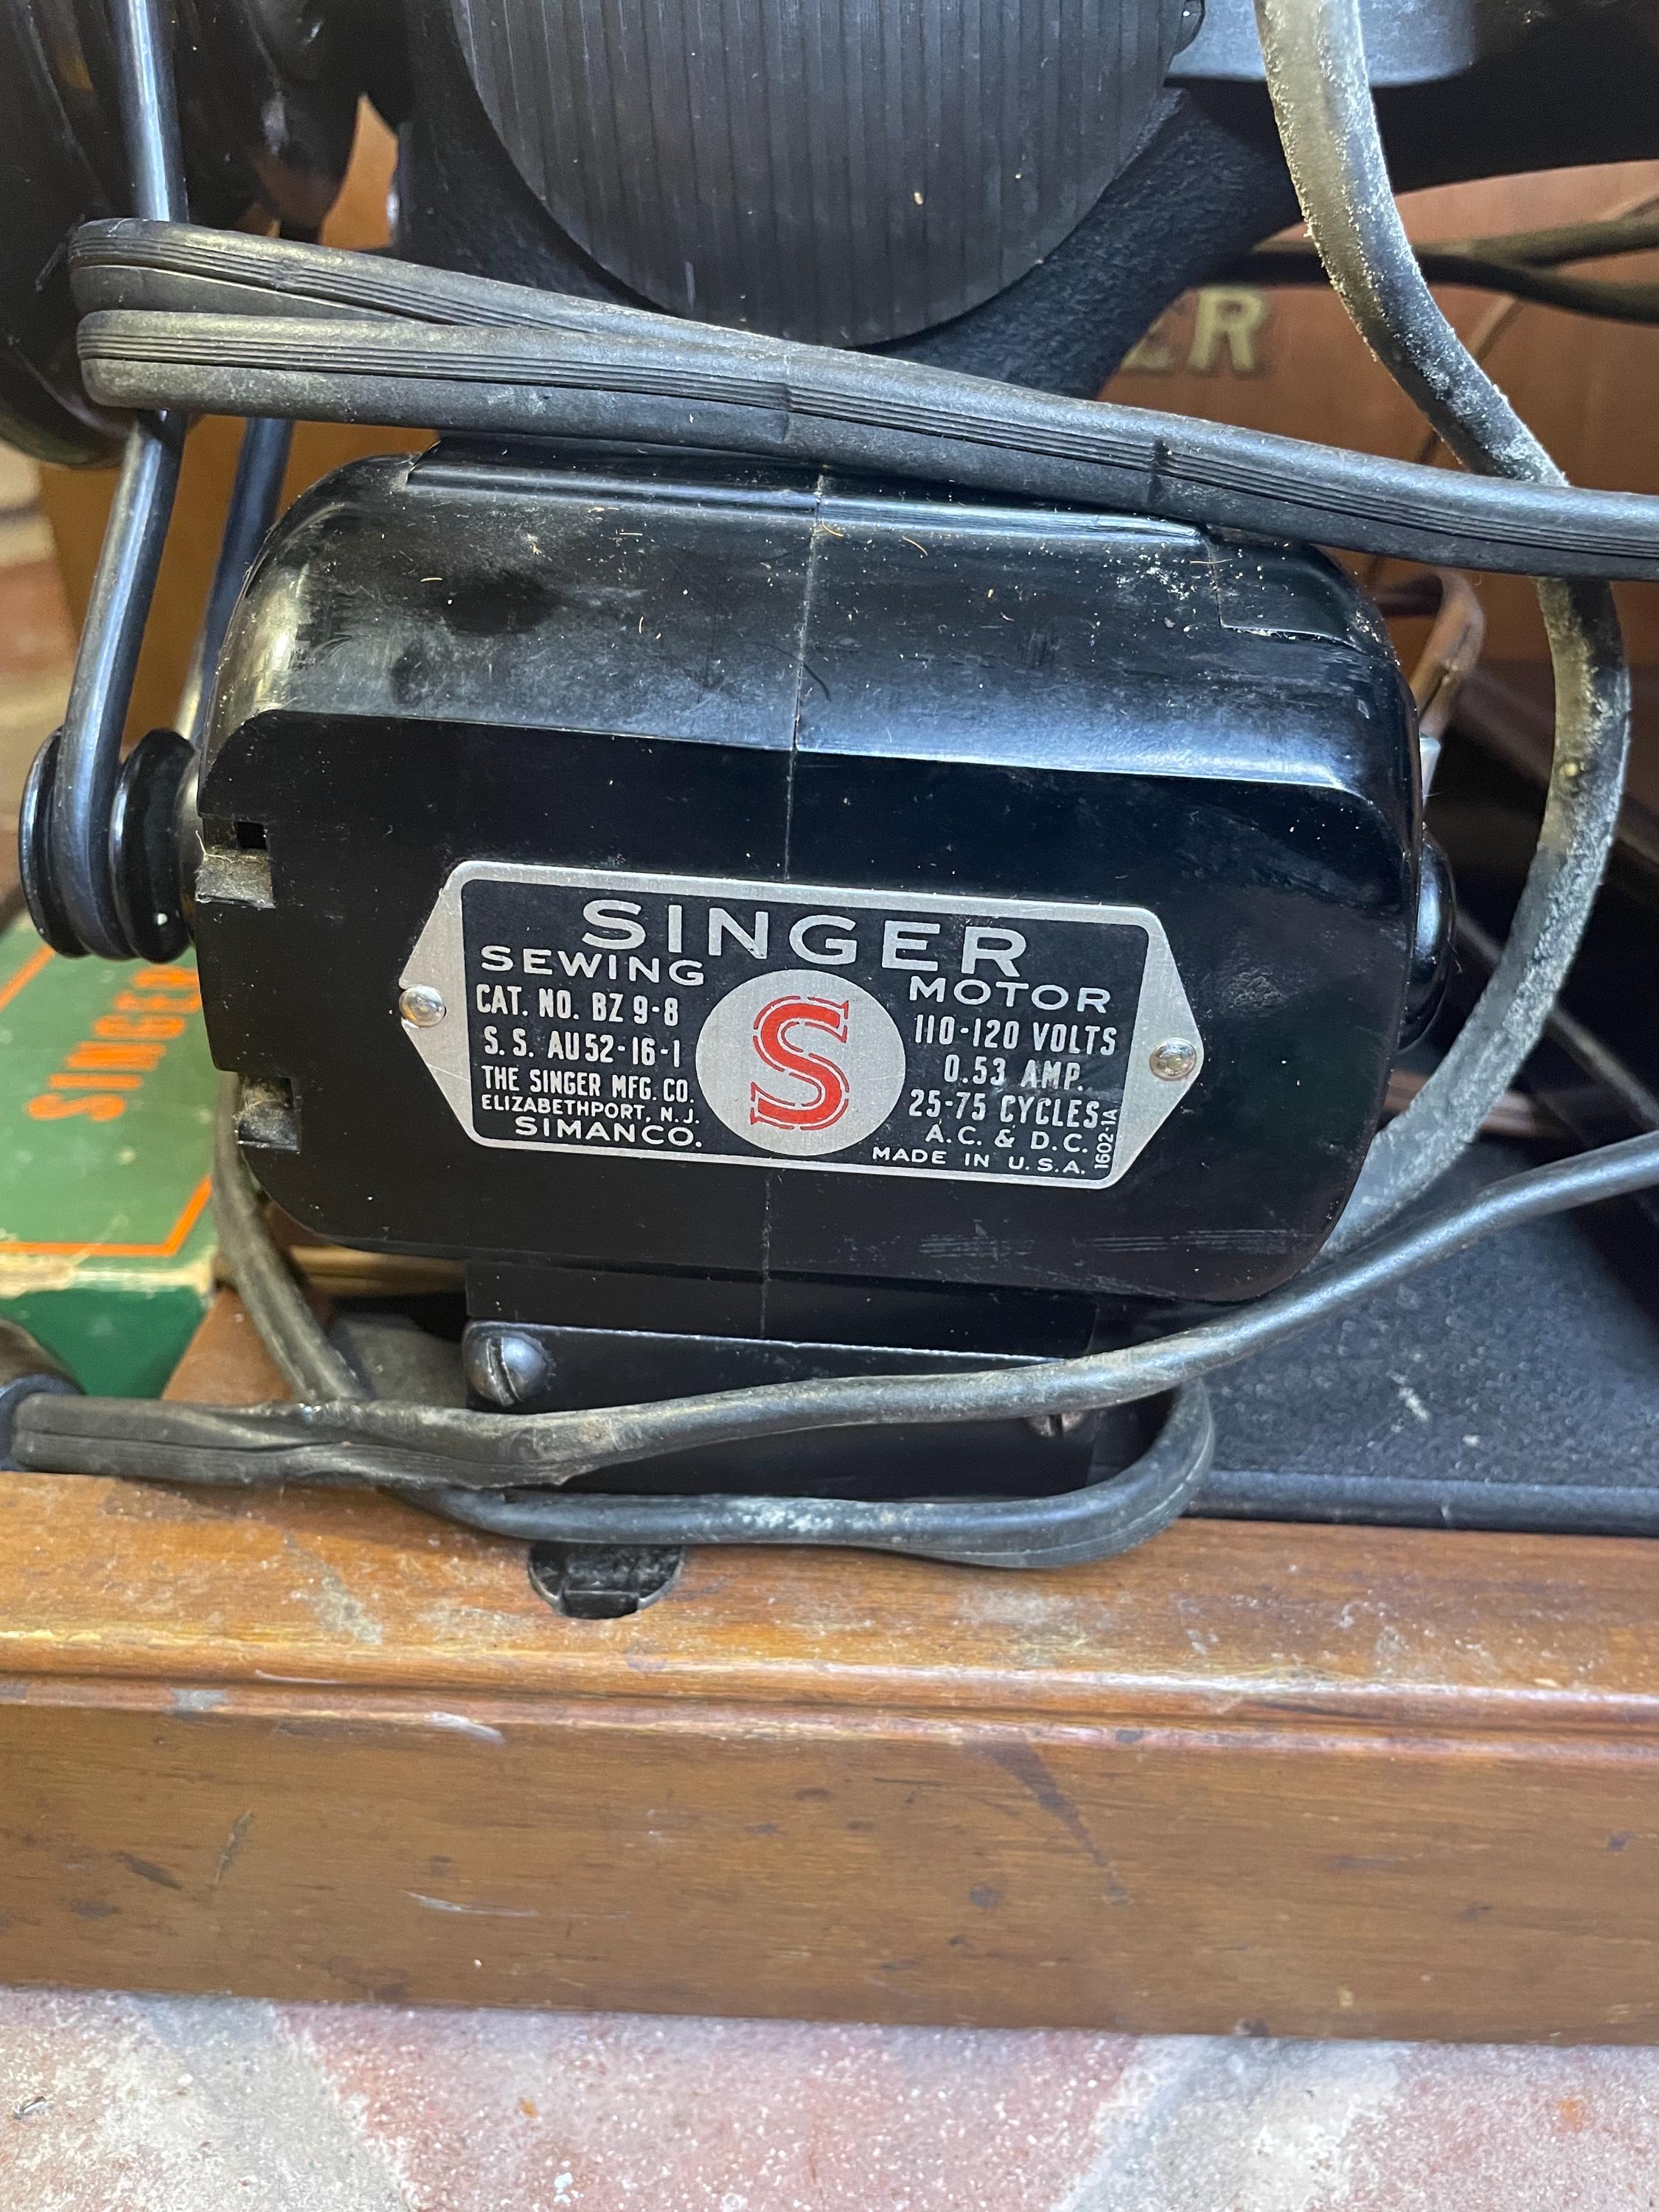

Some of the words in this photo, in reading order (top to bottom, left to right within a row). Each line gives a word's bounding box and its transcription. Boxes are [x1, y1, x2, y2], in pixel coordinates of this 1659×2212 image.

[581, 899, 1027, 978] SINGER
[481, 945, 704, 986] SEWING
[476, 984, 529, 1017] CAT.
[538, 987, 580, 1020] NO.
[909, 975, 1111, 1014] MOTOR
[915, 1014, 1020, 1049] 110-120
[1032, 1021, 1117, 1056] VOLTS
[750, 995, 850, 1131] S
[944, 1054, 1007, 1087] 0.53
[1019, 1059, 1083, 1091] AMP.
[481, 1065, 520, 1091] THE
[529, 1068, 601, 1097] SINGER
[611, 1074, 657, 1101] MFG.
[663, 1078, 695, 1104] CO.
[481, 1093, 651, 1123] ELIZABETHPORT,
[908, 1088, 987, 1121] 25-75
[1000, 1094, 1100, 1129] CYCLES
[515, 1116, 702, 1148] SIMANCO.
[994, 1129, 1016, 1148] &
[872, 1146, 947, 1164] MADE
[964, 1152, 990, 1168] IN
[1008, 1155, 1086, 1175] U.S.A.
